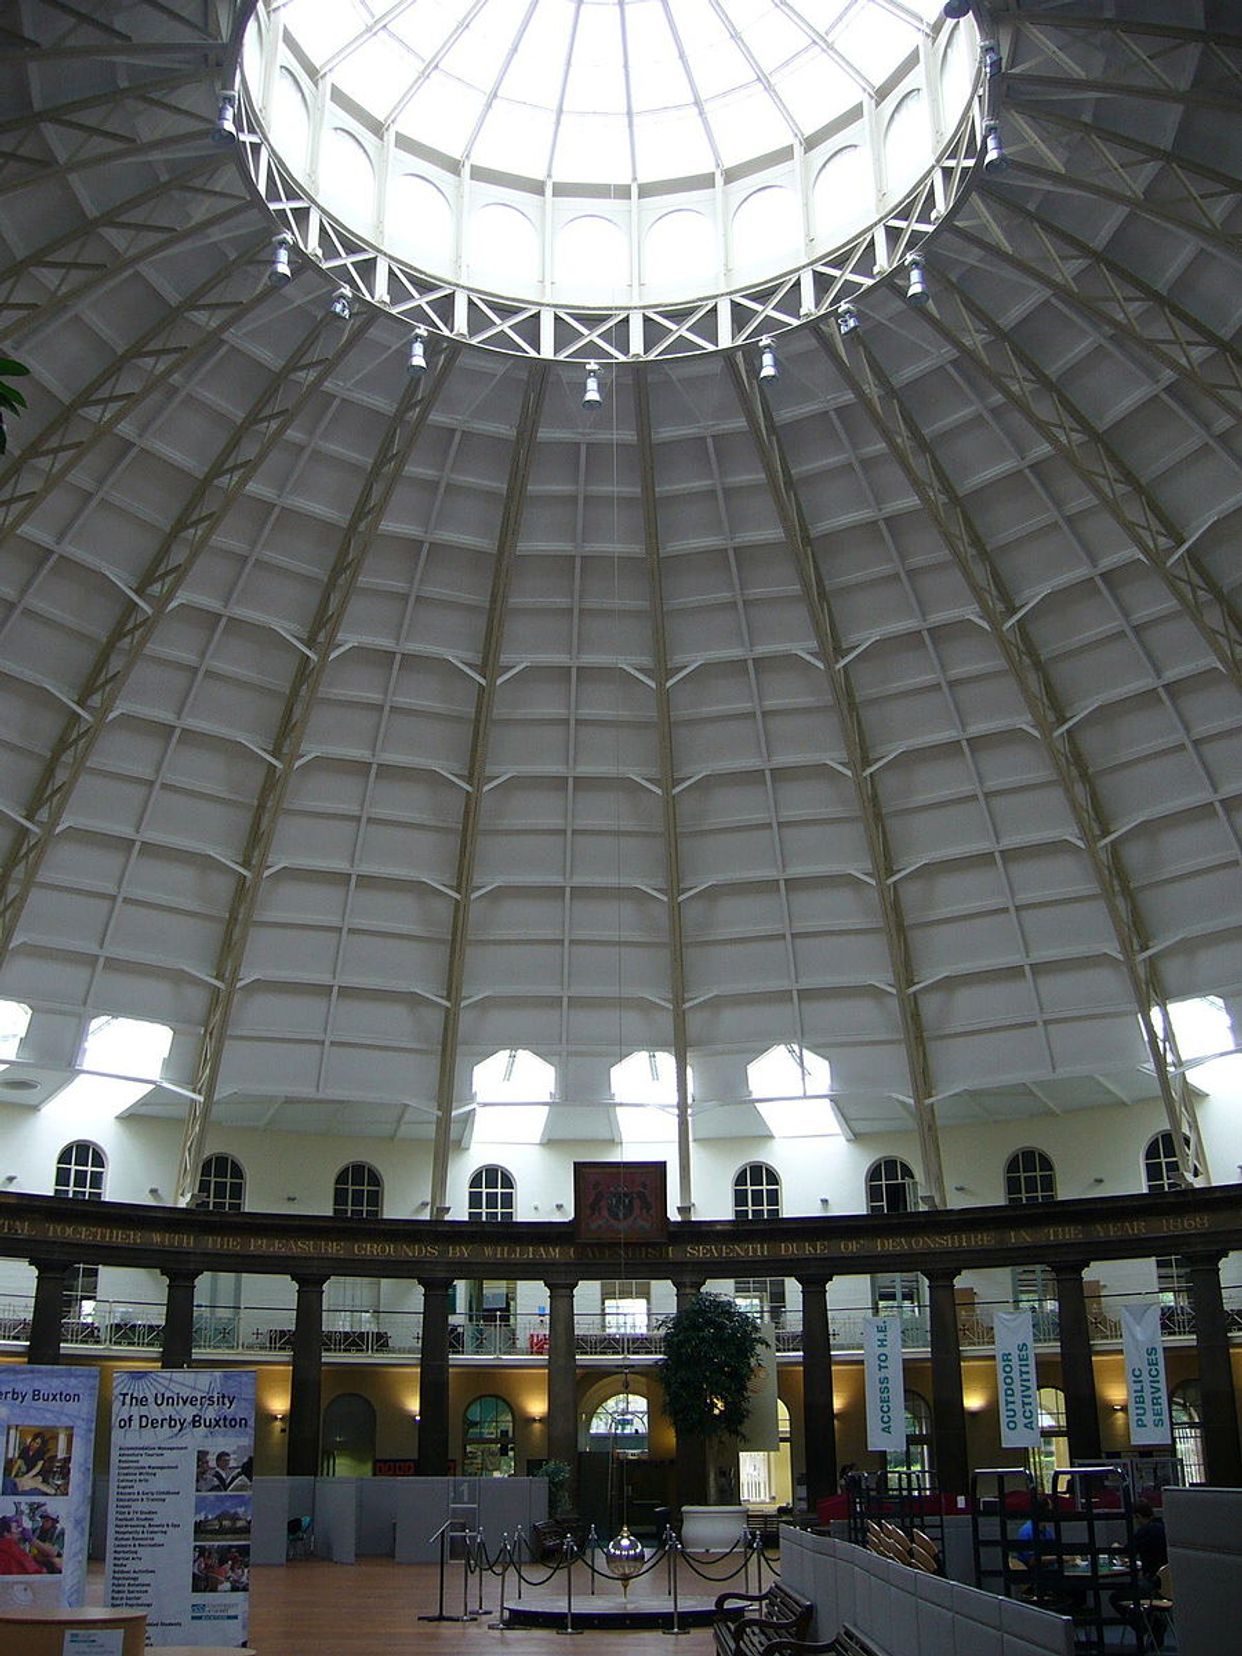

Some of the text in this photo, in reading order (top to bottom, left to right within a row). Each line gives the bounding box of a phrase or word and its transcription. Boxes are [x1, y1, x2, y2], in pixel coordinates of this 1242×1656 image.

[46, 1224, 141, 1243] TOGETHER
[152, 1231, 194, 1247] WITH
[205, 1236, 240, 1250] THE
[249, 1238, 344, 1255] PLEASURE
[354, 1242, 439, 1257] GROUNDS
[449, 1246, 472, 1258] BY
[483, 1246, 560, 1259] WILLIAM
[570, 1246, 673, 1259] CAVNISH
[686, 1243, 768, 1258] SEVENTH
[781, 1241, 828, 1255] DUKE
[840, 1240, 864, 1253] OF
[873, 1232, 995, 1251] DEVONSHIRE
[1009, 1229, 1032, 1243] IN
[1043, 1226, 1082, 1241] THE
[1092, 1221, 1147, 1236] YEAR
[32, 1389, 81, 1404] Buxton
[119, 1392, 236, 1409] The University
[876, 1320, 892, 1435] ACCESS TO H.E.
[1001, 1352, 1017, 1431] OUTDOOR
[1017, 1342, 1034, 1431] ACTIVITIES
[1131, 1367, 1147, 1428] PUBLIC
[1146, 1347, 1164, 1428] SERVICES
[118, 1415, 249, 1432] of Derby Buxton
